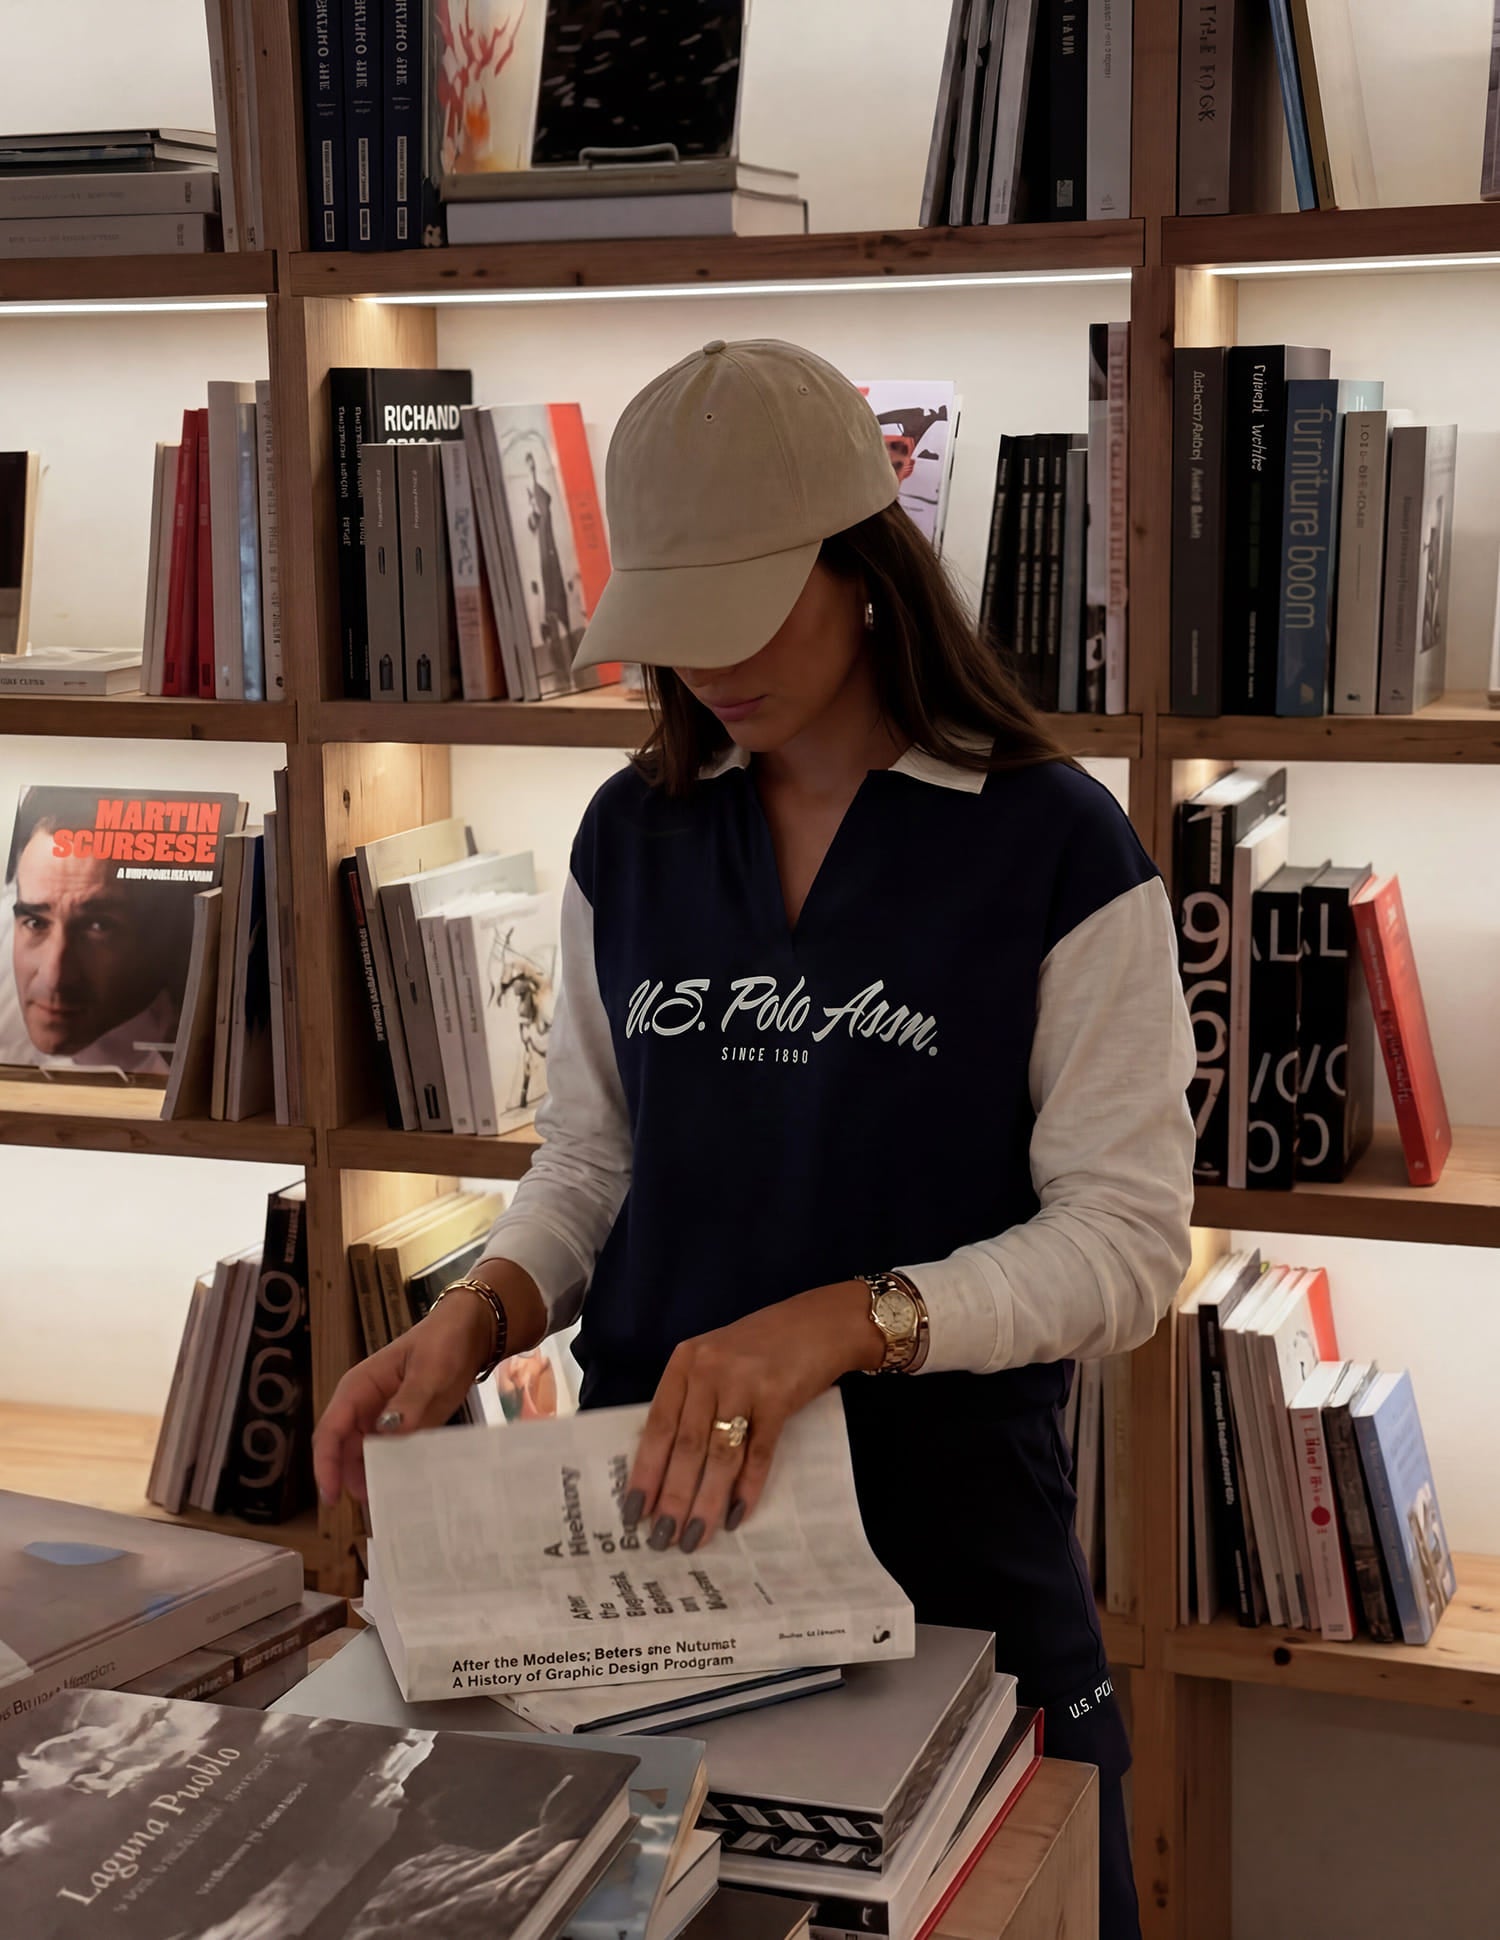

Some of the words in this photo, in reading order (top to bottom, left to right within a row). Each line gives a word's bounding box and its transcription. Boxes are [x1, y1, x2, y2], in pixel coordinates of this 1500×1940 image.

[384, 404, 461, 432] RICHAND
[1288, 403, 1333, 538] furniture
[1284, 546, 1327, 630] boom
[95, 799, 222, 833] MARTIN
[52, 829, 218, 863] SCURSESE
[625, 978, 711, 1039] U.S.
[720, 975, 811, 1034] Polo
[811, 979, 939, 1057] Assn.
[721, 1046, 765, 1062] SINCE
[774, 1048, 809, 1064] 1890
[543, 1540, 564, 1558] A
[593, 1530, 616, 1554] of
[452, 1659, 490, 1673] After
[494, 1656, 518, 1669] the
[522, 1651, 591, 1667] Modeles;
[595, 1645, 643, 1661] Beters
[452, 1676, 464, 1689] A
[467, 1670, 522, 1688] History
[526, 1668, 541, 1682] of
[546, 1663, 604, 1682] Graphic
[608, 1659, 660, 1676] Design
[664, 1655, 735, 1671] Prodgram
[1068, 1697, 1093, 1719] U.S.
[56, 1814, 171, 1907] Laguna
